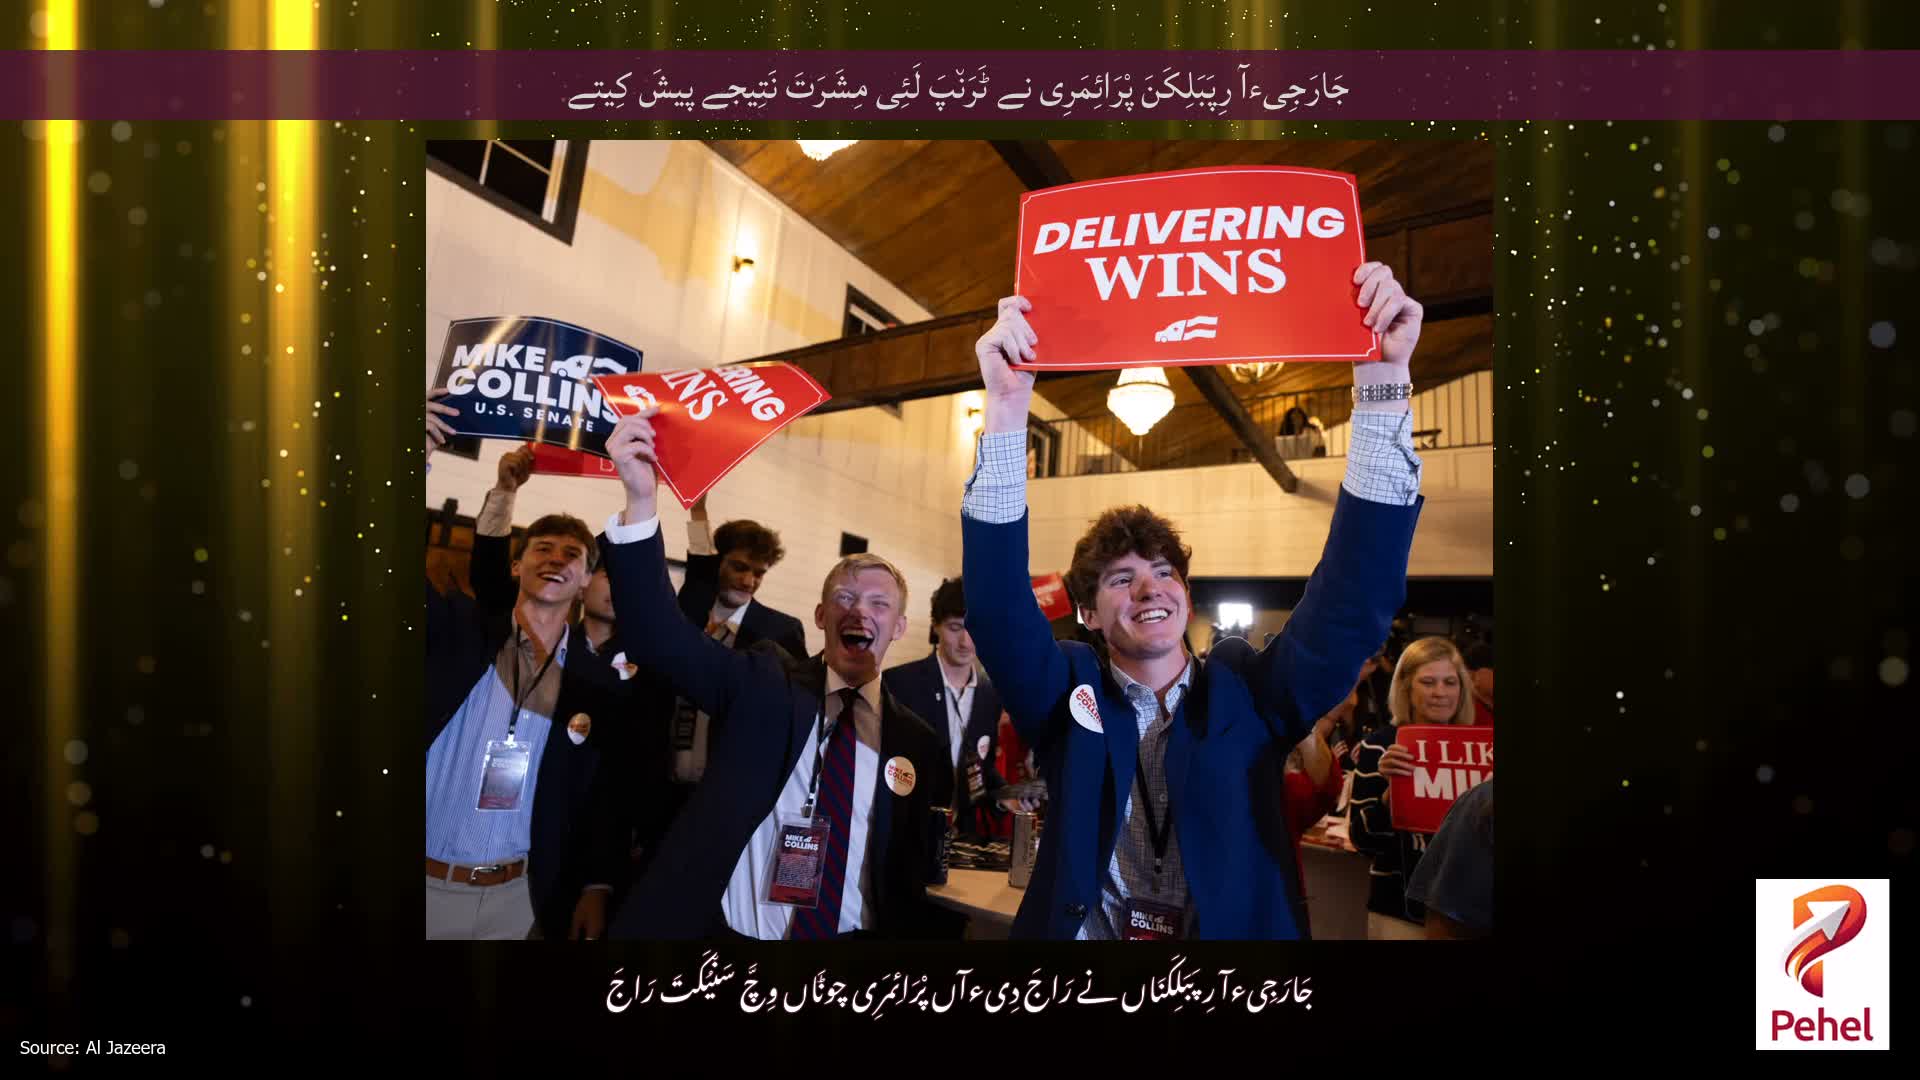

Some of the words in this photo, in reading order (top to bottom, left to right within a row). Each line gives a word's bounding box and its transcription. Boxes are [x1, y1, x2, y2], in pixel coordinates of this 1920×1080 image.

[1033, 205, 1345, 255] DELIVERING
[1085, 248, 1287, 301] WINS
[452, 343, 546, 372] MIKE
[475, 402, 514, 417] U.S.
[523, 407, 594, 432] SENATE
[1416, 739, 1428, 763] I
[784, 840, 819, 851] COLLINS
[785, 834, 804, 843] MIKE
[1130, 918, 1174, 935] COLLINS
[1131, 910, 1153, 922] MIKE
